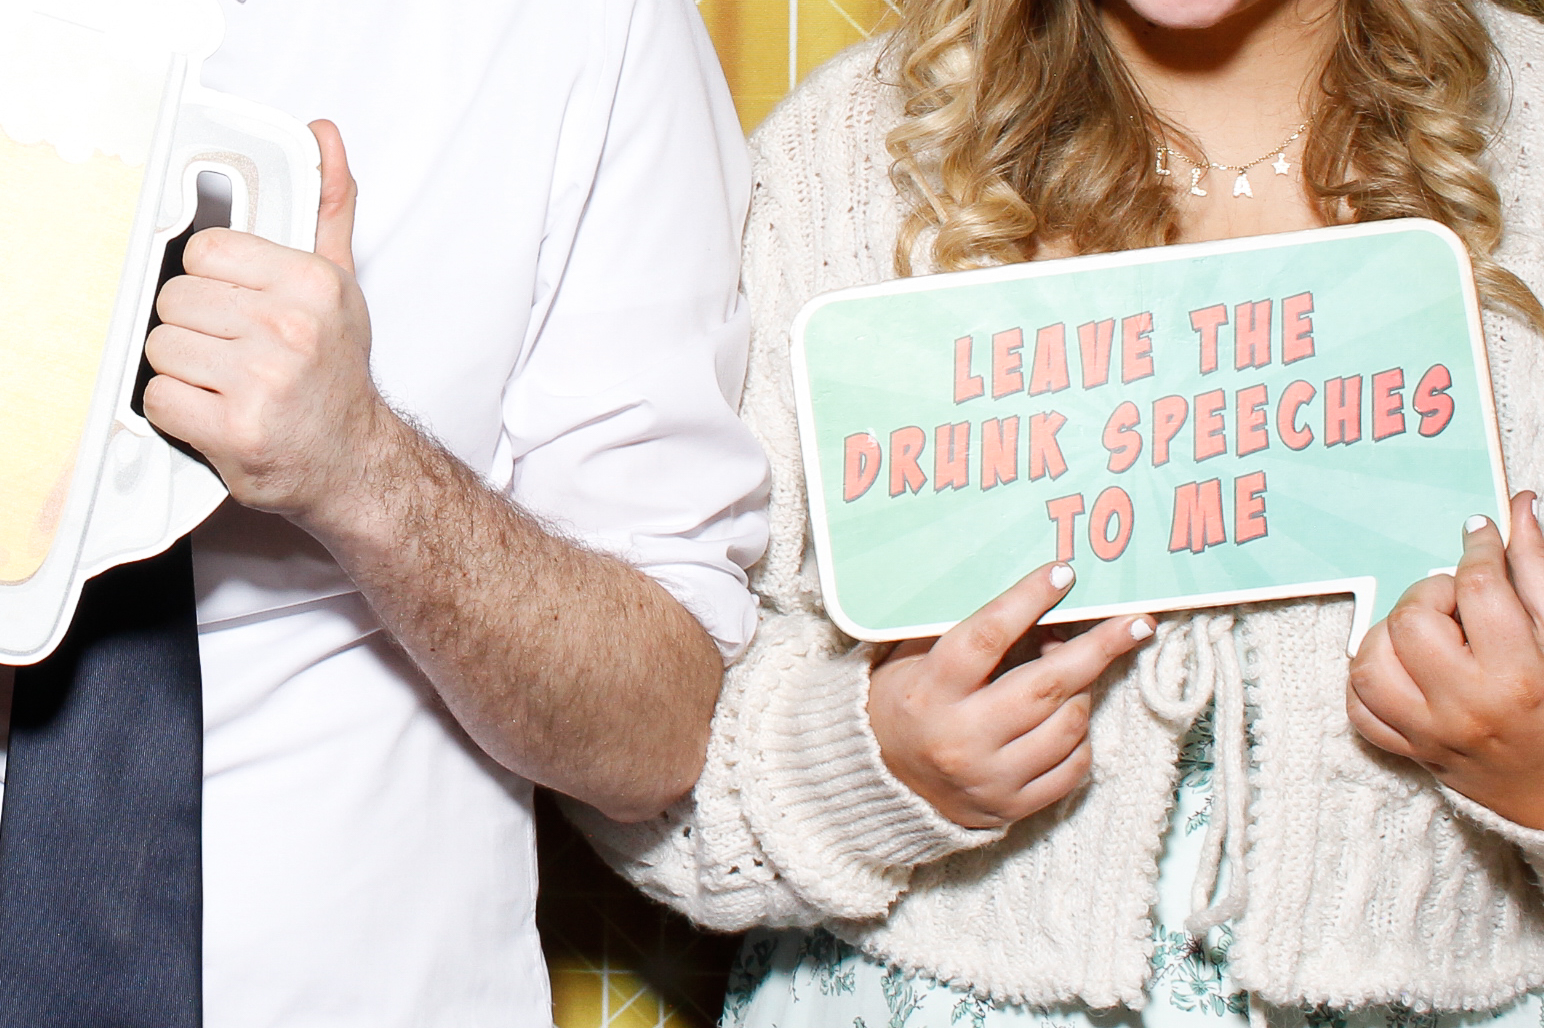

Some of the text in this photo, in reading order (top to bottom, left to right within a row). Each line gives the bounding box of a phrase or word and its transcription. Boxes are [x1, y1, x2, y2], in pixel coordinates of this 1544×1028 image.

[953, 290, 1316, 405] LEAVE THE
[842, 363, 1455, 503] DRUNK SPEECHES
[1045, 469, 1269, 563] TO ME
